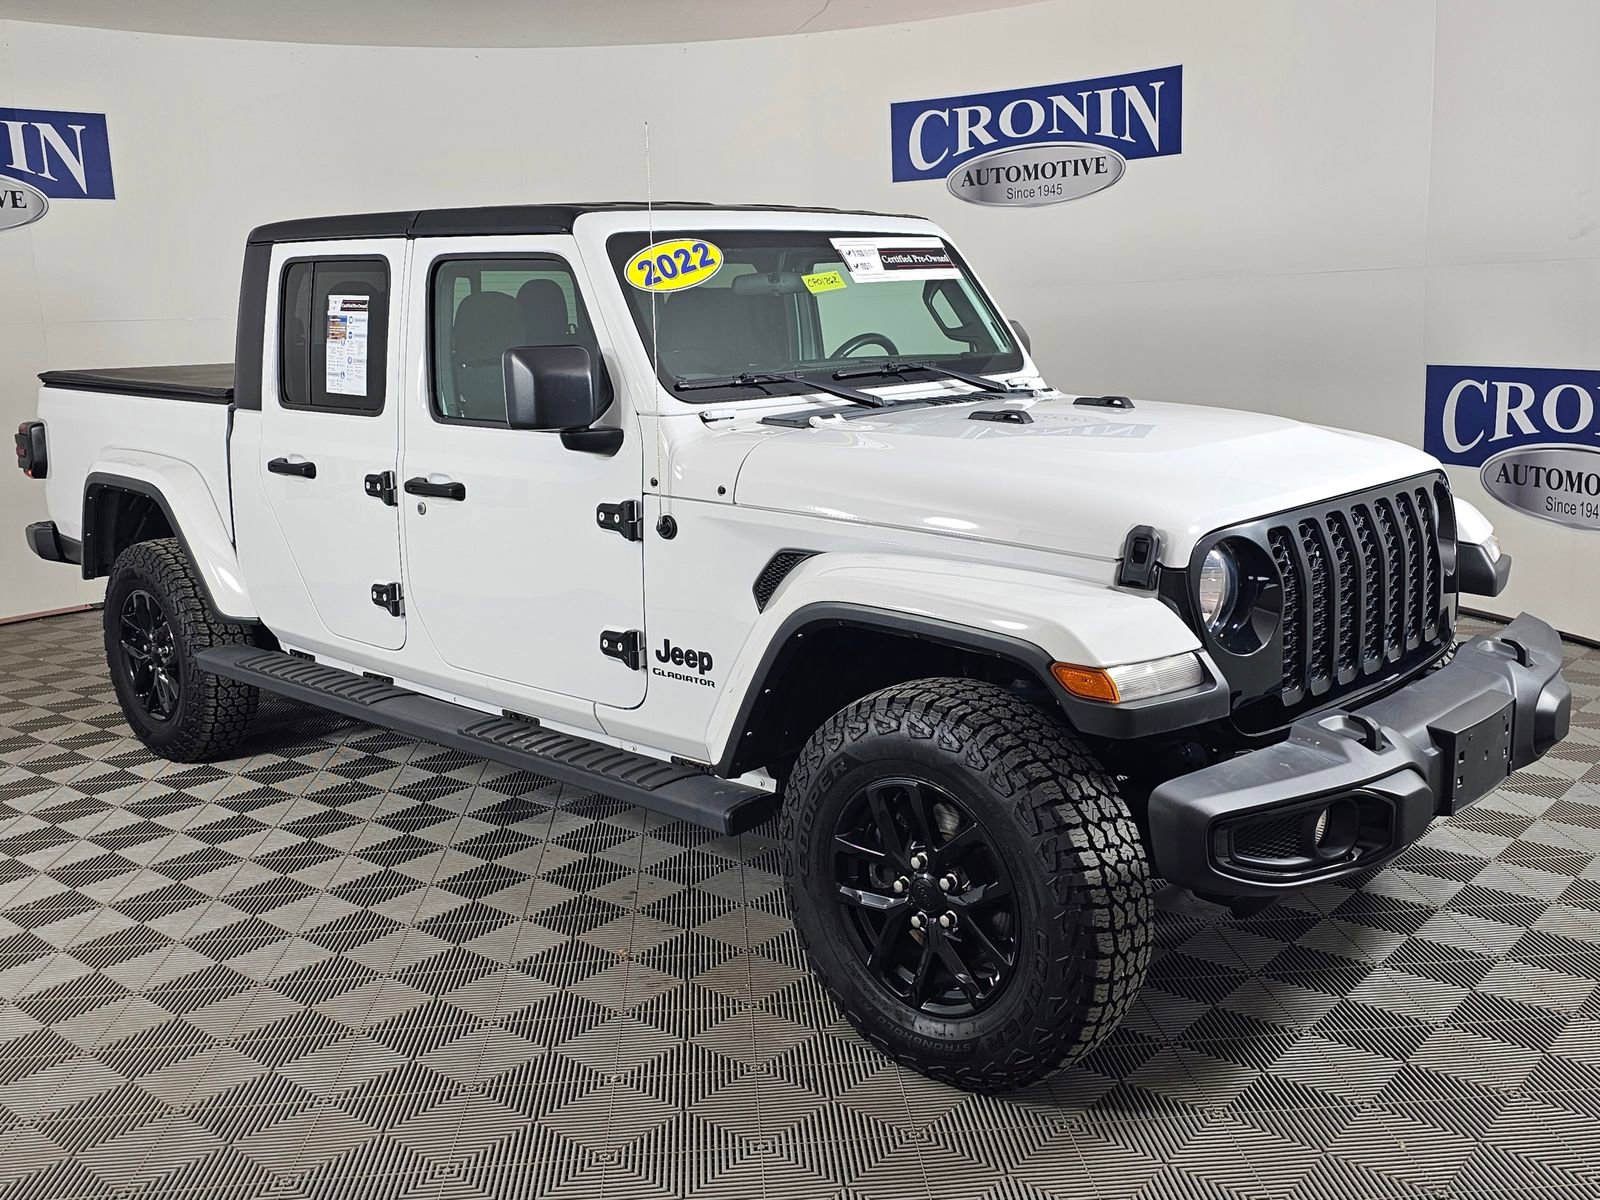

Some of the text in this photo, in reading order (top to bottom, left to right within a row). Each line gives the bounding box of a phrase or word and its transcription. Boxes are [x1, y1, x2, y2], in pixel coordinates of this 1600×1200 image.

[908, 81, 1165, 172] CRONIN
[961, 156, 1108, 187] AUTOMOTIVE
[1006, 183, 1063, 200] Since 1945
[637, 243, 715, 287] 2022
[881, 253, 950, 264] Certified Pre-Owned
[1442, 379, 1600, 454] CRO
[1496, 462, 1600, 496] AUTOMO
[1545, 496, 1600, 519] Since 194
[655, 638, 713, 676] Jeep
[652, 667, 716, 689] GLADIATOR
[798, 756, 848, 877] COOPER
[876, 1015, 972, 1053] STRONGHOLD
